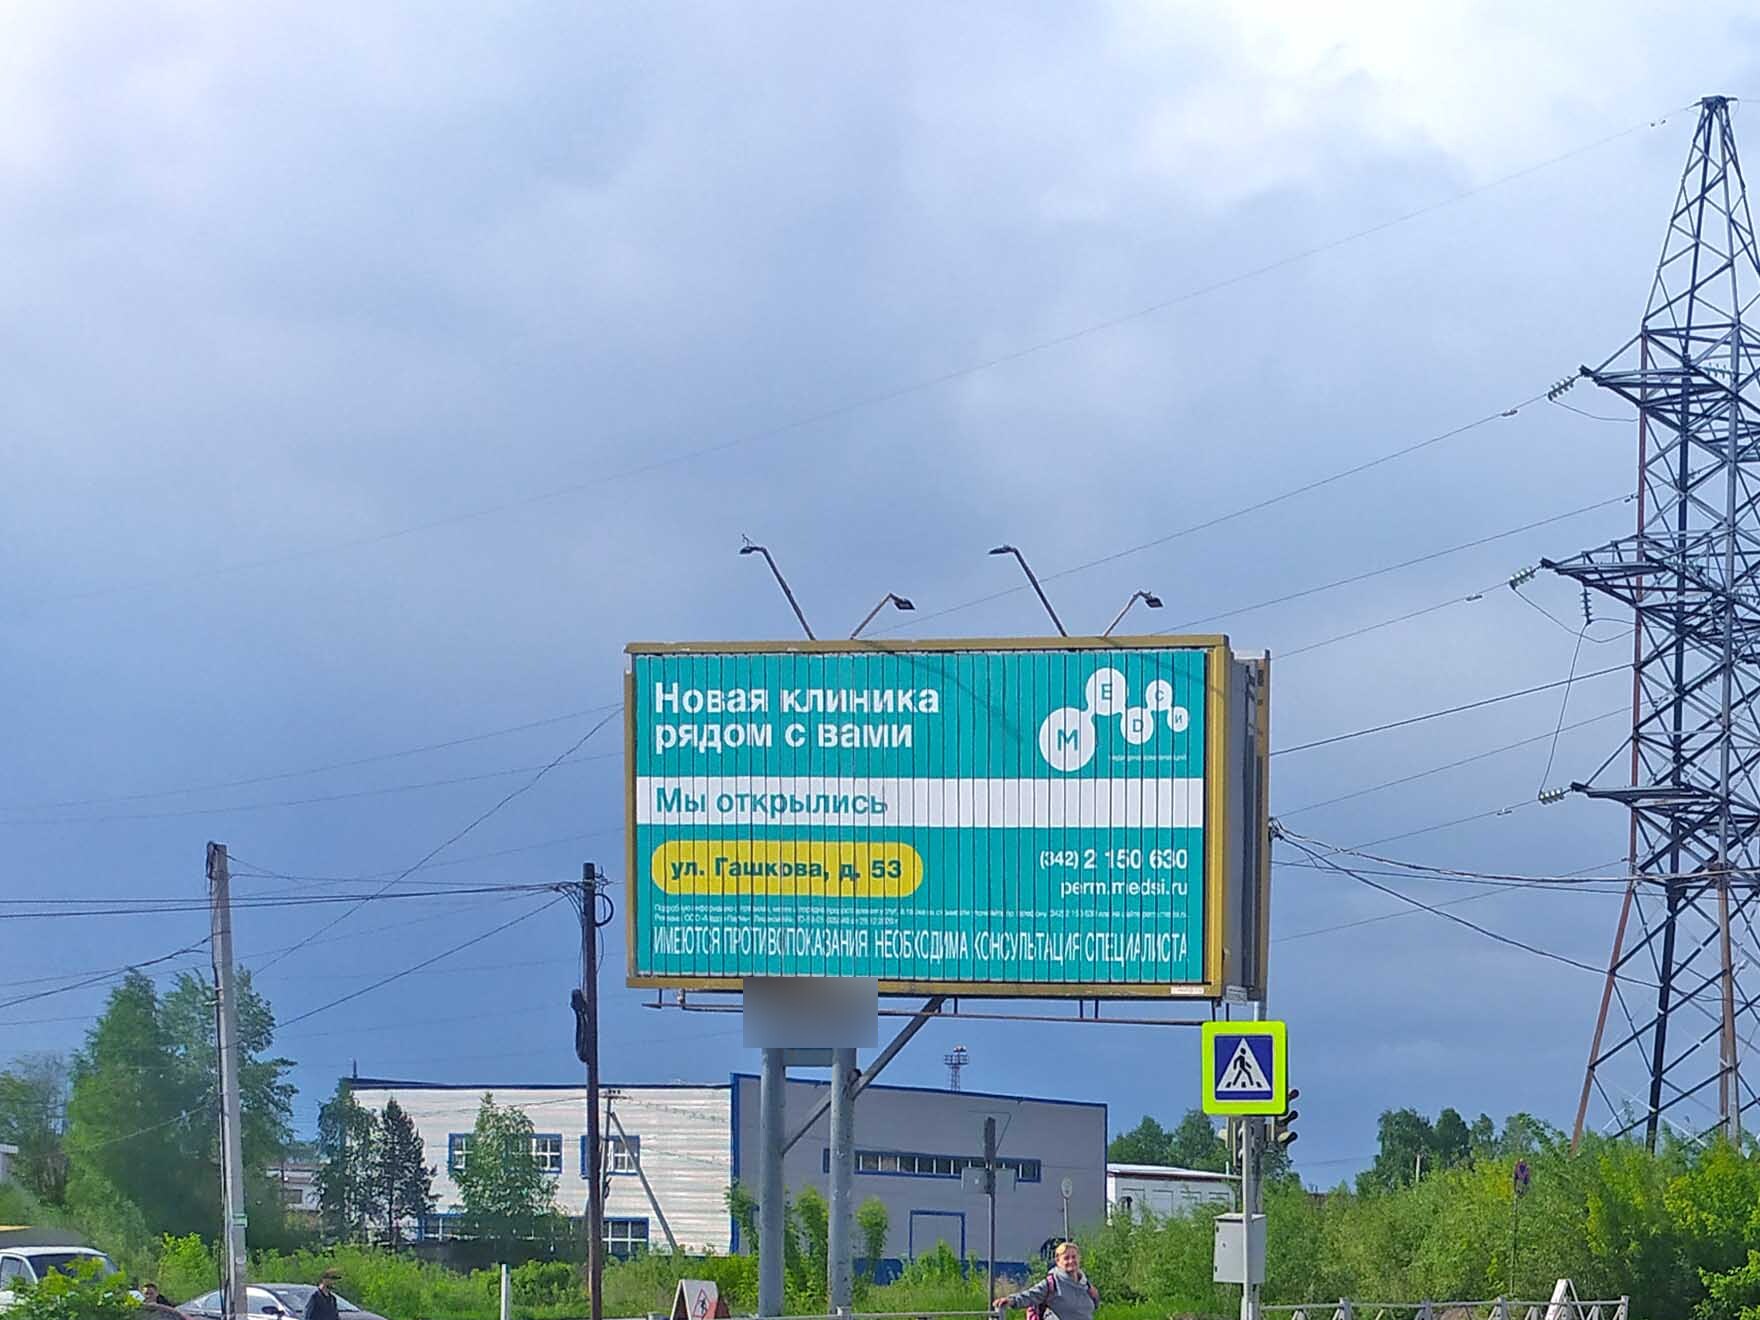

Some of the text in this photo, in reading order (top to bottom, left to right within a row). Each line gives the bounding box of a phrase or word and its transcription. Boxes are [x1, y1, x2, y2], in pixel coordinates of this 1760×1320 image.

[655, 682, 939, 713] Новая клиника
[655, 723, 913, 754] рядом с вами
[656, 787, 888, 818] Мы открылись
[671, 861, 705, 881] ул.
[715, 857, 830, 882] Гашкова,
[871, 860, 902, 879] 53
[1039, 848, 1188, 870] (342) 2 150 630
[1060, 878, 1188, 898] perm.medsi.ru
[653, 926, 720, 955] ИМЕЮТСЯ
